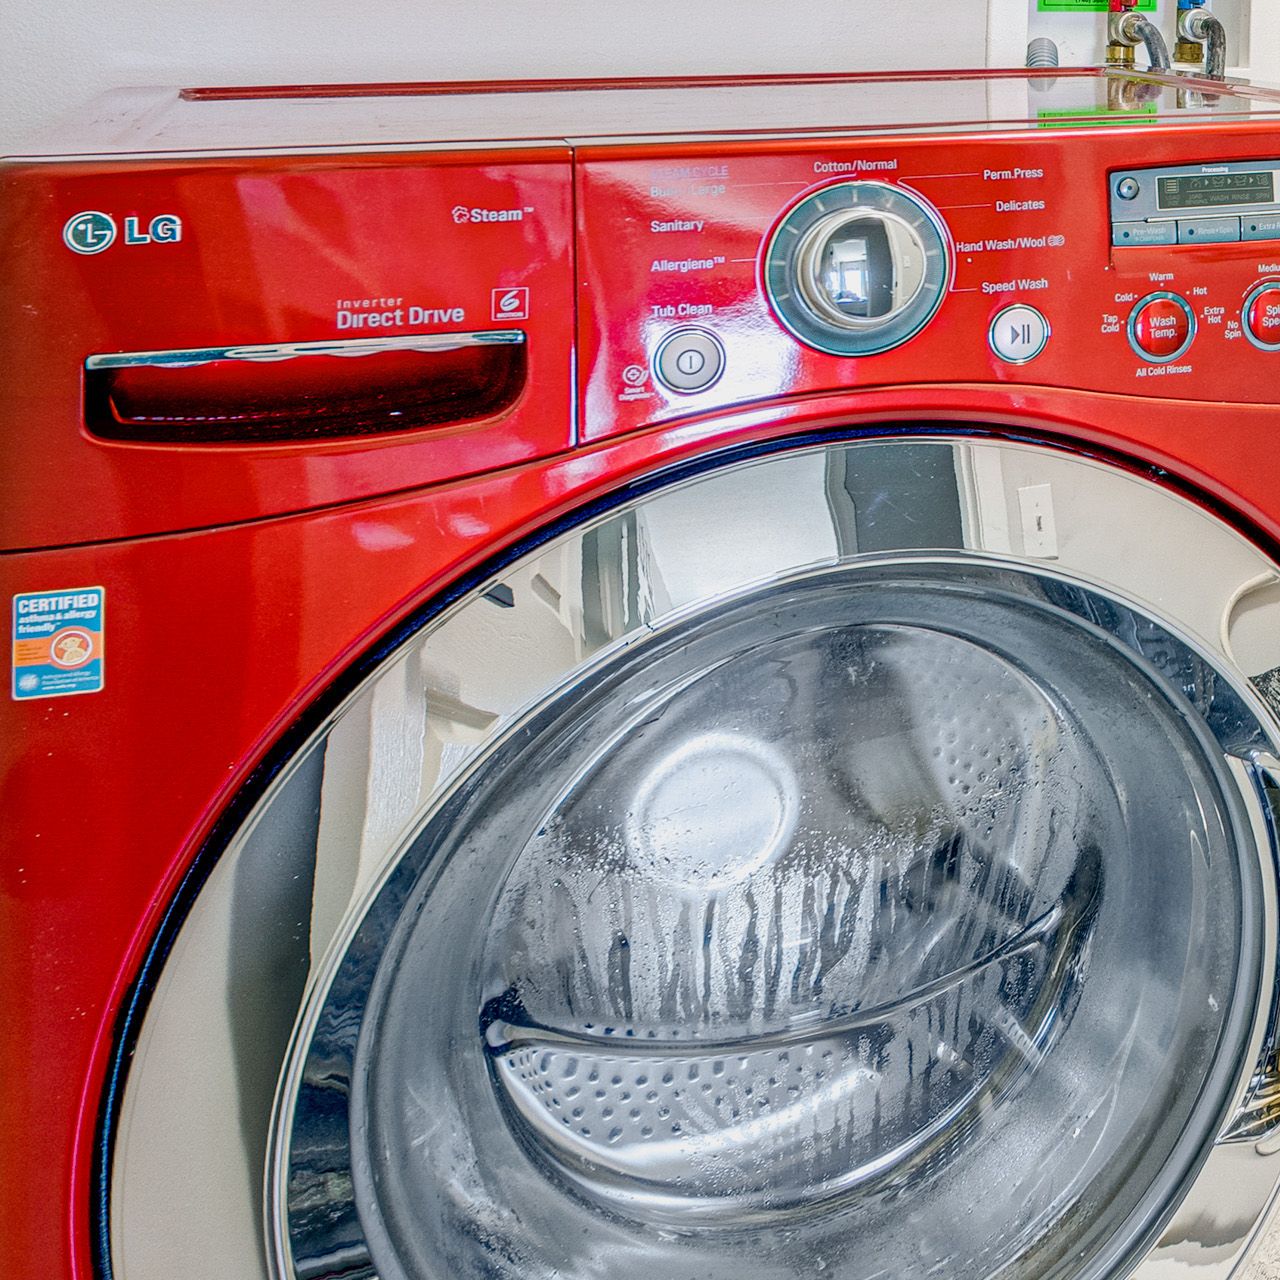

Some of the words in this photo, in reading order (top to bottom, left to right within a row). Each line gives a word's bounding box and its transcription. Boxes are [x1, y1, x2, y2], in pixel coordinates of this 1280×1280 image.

[813, 158, 898, 173] Cotton/Normal
[983, 167, 1044, 180] Perm.Press
[995, 200, 1045, 212] Delicates
[124, 214, 182, 245] LG
[651, 219, 704, 234] Sanitary
[1259, 223, 1275, 231] Extra
[955, 241, 983, 253] Hand
[985, 236, 1046, 251] Wash/Wool
[1149, 272, 1174, 282] Warm
[981, 281, 1016, 294] Speed
[1017, 277, 1048, 291] Wash
[1192, 286, 1208, 296] Hot
[336, 296, 403, 308] Inverter
[1114, 293, 1133, 302] Cold
[651, 304, 676, 317] Tub
[677, 303, 713, 316] Clean
[1203, 306, 1225, 315] Extra
[336, 308, 403, 330] Direct
[408, 306, 465, 325] Drive
[1102, 314, 1119, 325] Tap
[1149, 315, 1177, 327] Wash
[1207, 314, 1222, 324] Hot
[1101, 323, 1120, 333] Cold
[1227, 320, 1239, 329] No
[1149, 327, 1178, 338] Temp.
[1224, 329, 1242, 340] Spin
[1135, 367, 1147, 377] All
[1147, 366, 1166, 376] Cold
[1166, 364, 1192, 374] Rinses
[18, 593, 99, 614] CERTIFIED
